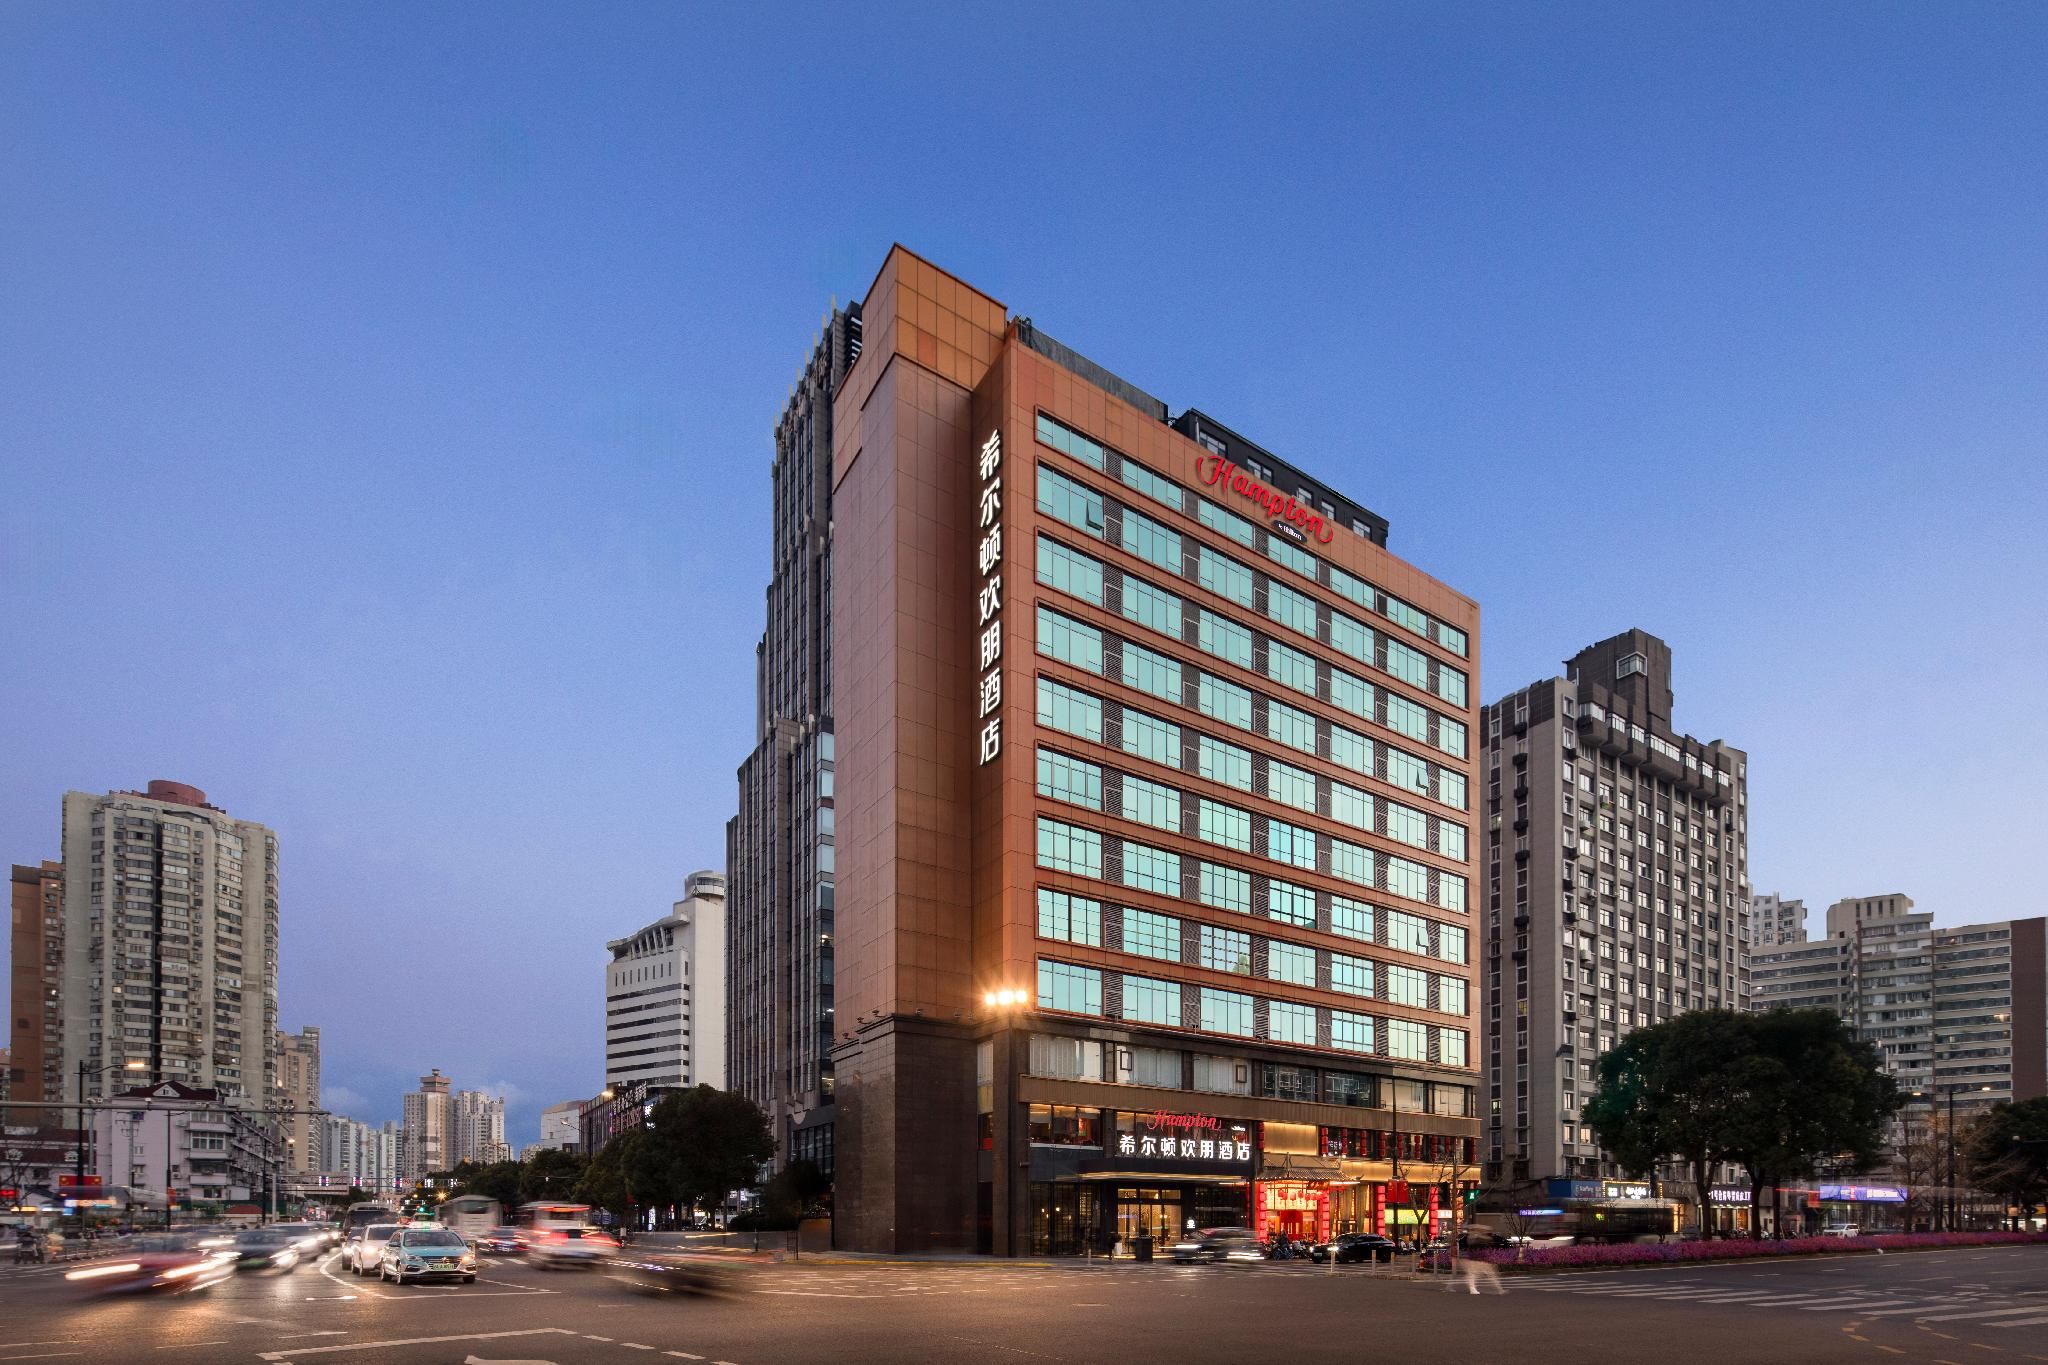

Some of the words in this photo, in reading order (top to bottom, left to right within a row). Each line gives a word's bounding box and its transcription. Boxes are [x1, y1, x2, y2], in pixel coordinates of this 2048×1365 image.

[1197, 455, 1334, 543] Hampton
[979, 429, 1002, 766] 希尔顿欢朋酒店
[1119, 1134, 1251, 1161] 希尔顿欢朋酒店
[1146, 1109, 1222, 1132] Hampton
